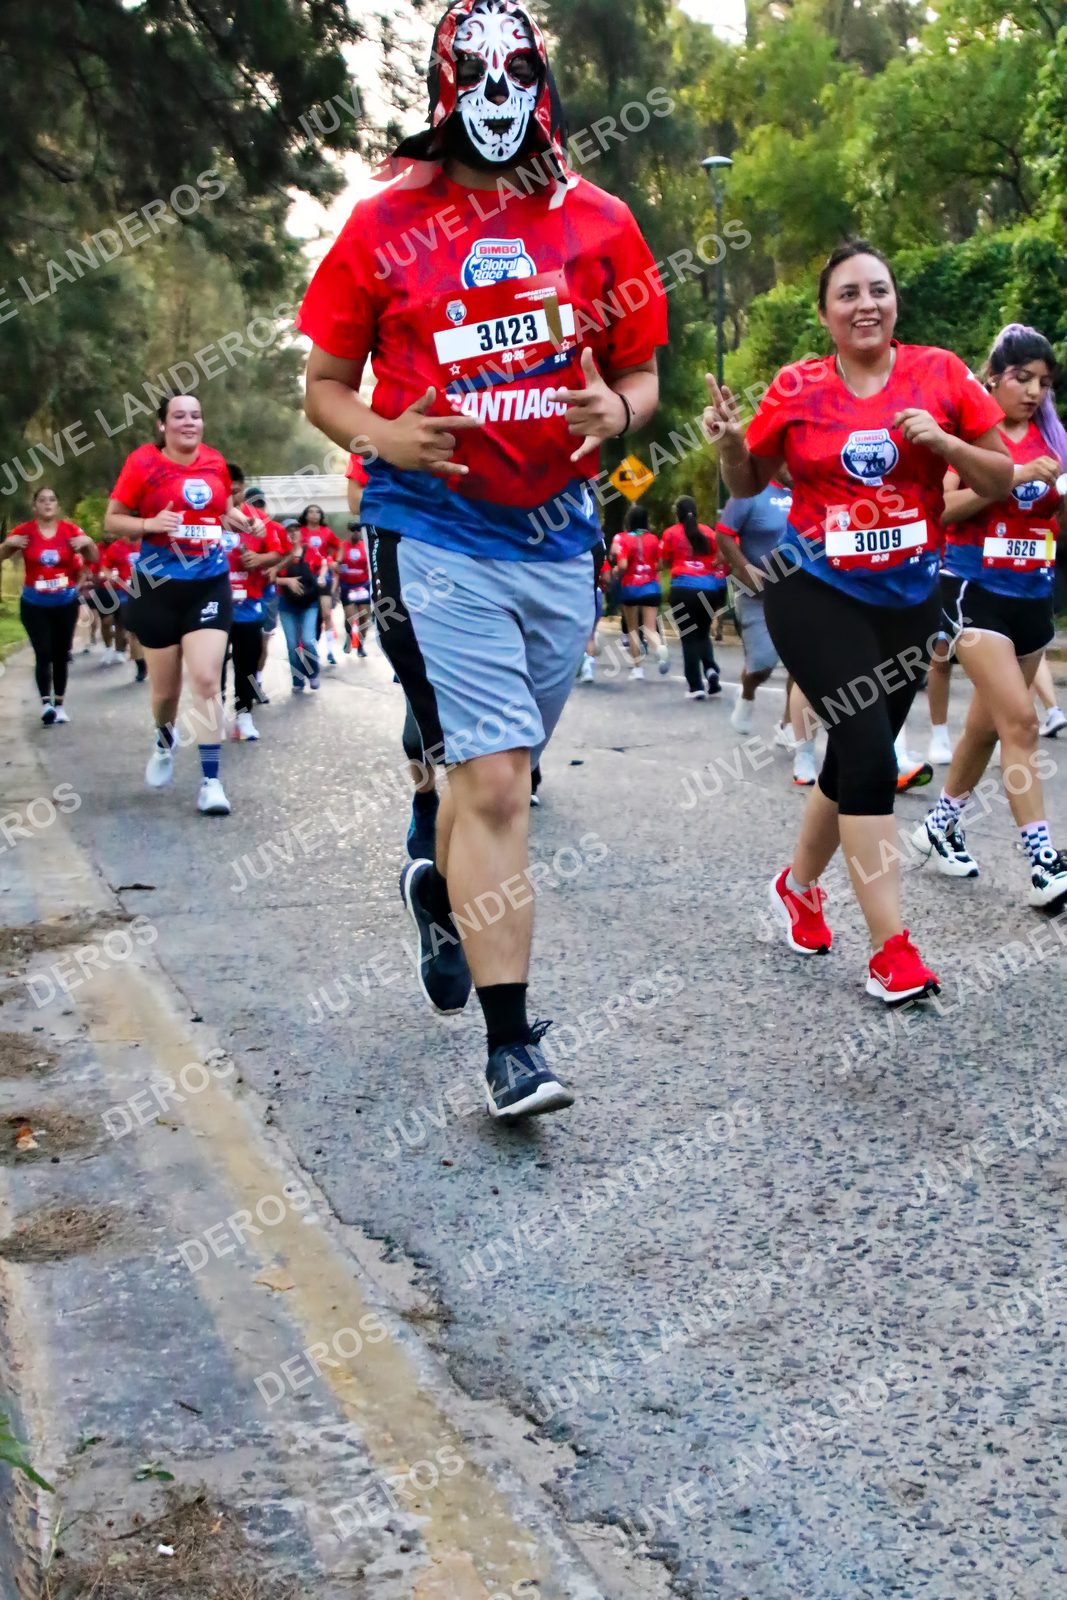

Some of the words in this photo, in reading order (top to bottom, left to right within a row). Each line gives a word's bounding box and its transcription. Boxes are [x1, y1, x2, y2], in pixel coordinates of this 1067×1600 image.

[479, 245, 518, 255] BIMBO
[480, 258, 518, 271] Global
[472, 269, 504, 281] Race
[476, 313, 539, 352] 3423
[855, 443, 885, 453] Global
[854, 528, 902, 553] 3009
[1006, 539, 1037, 557] 3626
